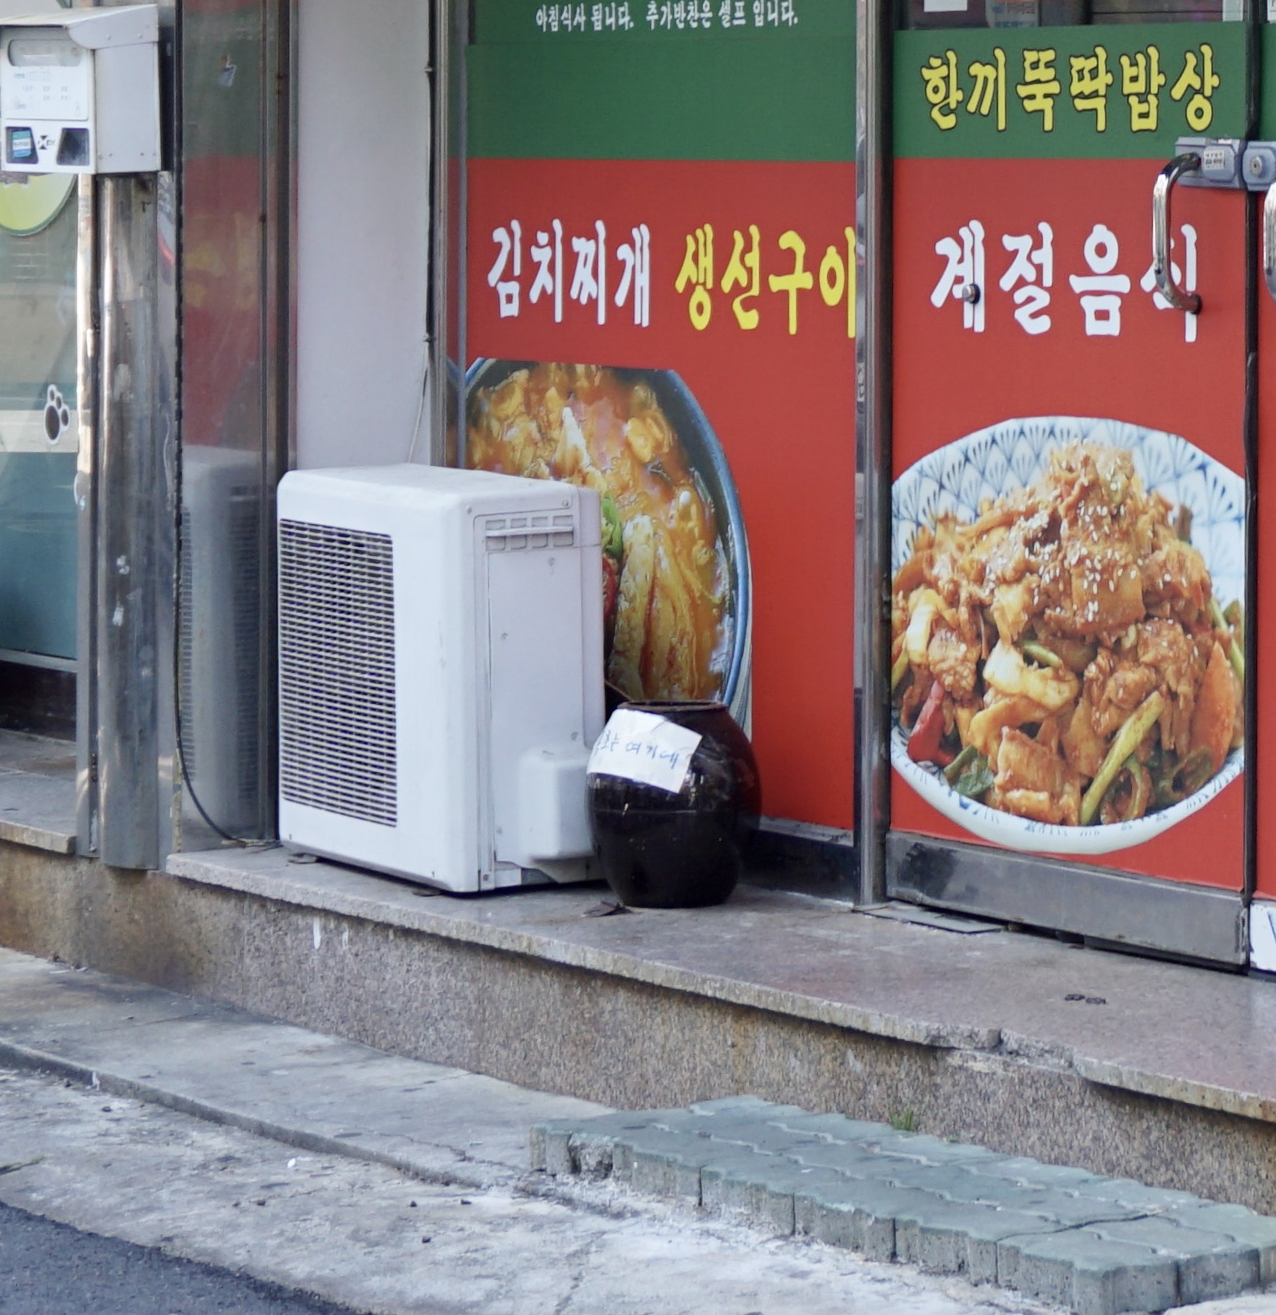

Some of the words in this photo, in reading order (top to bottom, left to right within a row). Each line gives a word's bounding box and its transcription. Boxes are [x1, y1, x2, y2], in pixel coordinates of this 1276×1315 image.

[535, 2, 586, 32] 아침식사
[590, 0, 635, 31] 됩니다.
[645, 0, 714, 31] 추가반찬은
[486, 217, 652, 330] 김치찌개
[674, 222, 857, 339] 생선구이
[930, 219, 1200, 344] 계절음식
